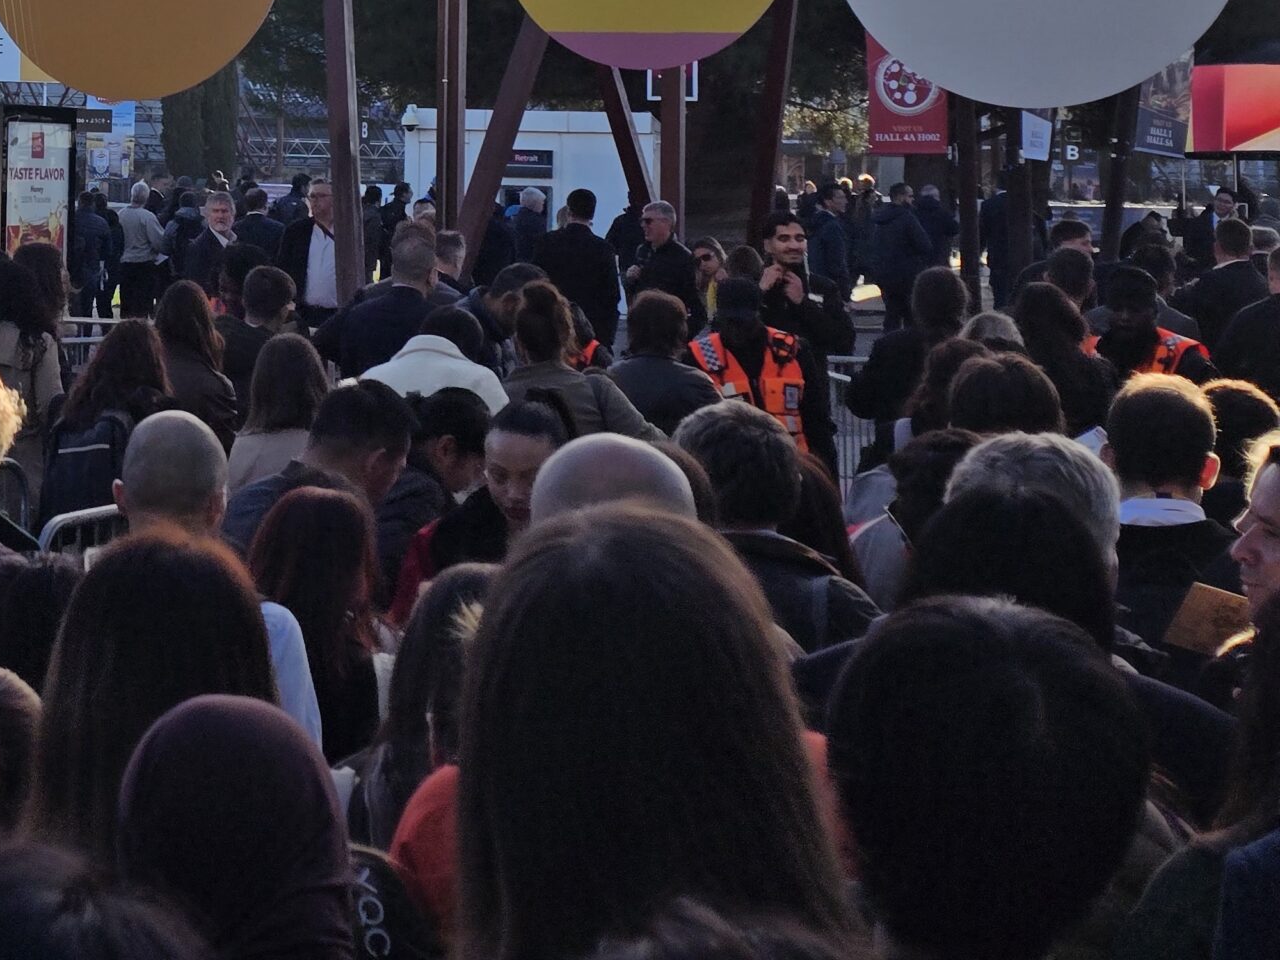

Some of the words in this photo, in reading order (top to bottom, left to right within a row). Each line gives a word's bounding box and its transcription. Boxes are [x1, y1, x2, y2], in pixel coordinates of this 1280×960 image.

[875, 133, 902, 142] HALL
[1066, 144, 1079, 160] B
[9, 167, 33, 180] TASTE
[34, 167, 65, 180] FLAVOR
